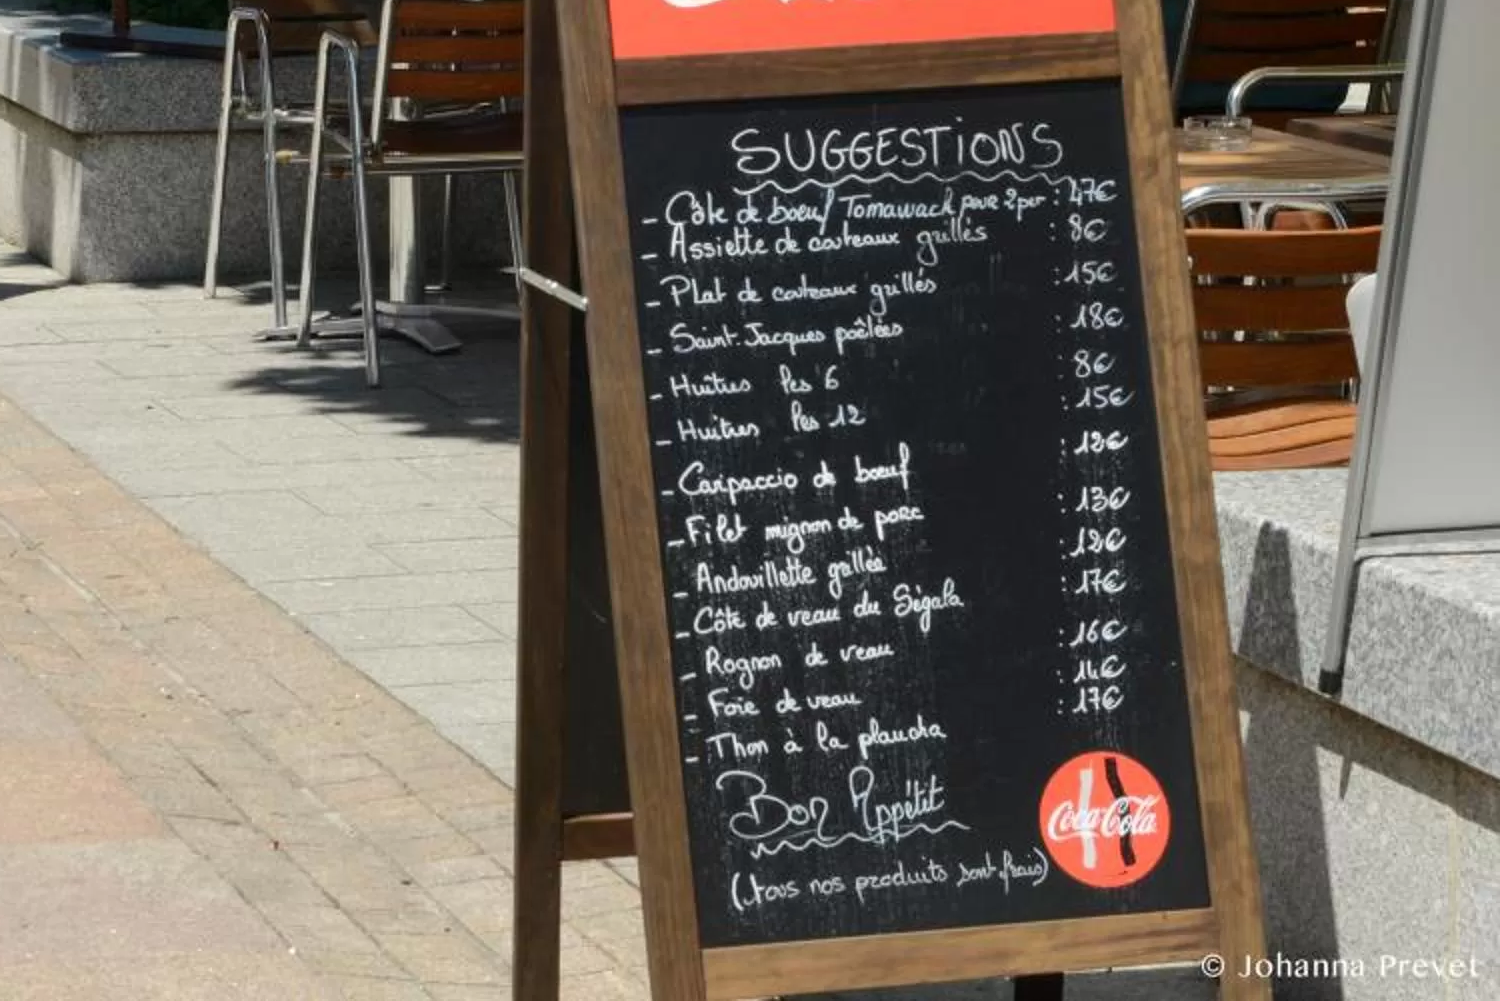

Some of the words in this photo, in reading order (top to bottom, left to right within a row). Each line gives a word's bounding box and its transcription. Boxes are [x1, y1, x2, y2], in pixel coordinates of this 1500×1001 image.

[731, 118, 1063, 175] SUGGESTIONS
[736, 194, 762, 225] de
[671, 222, 769, 263] Assiette
[775, 226, 802, 255] de
[659, 274, 728, 307] Plat
[737, 277, 763, 303] de
[779, 364, 812, 394] les
[824, 364, 839, 390] 6
[791, 400, 820, 432] les
[828, 404, 867, 427] 12
[678, 461, 799, 505] Carpaccio
[813, 460, 837, 488] de
[686, 513, 747, 545] Filet
[764, 515, 832, 553] mignon
[837, 506, 864, 530] de
[875, 506, 924, 541] porc
[696, 556, 817, 594] Andouillette
[693, 605, 746, 634] Côte
[755, 601, 778, 631] de
[788, 606, 841, 628] veau
[854, 589, 882, 618] du
[705, 645, 782, 690] Rognon
[805, 642, 828, 667] de
[840, 643, 895, 662] veau
[708, 688, 760, 717] Foie
[776, 688, 801, 714] de
[807, 692, 862, 709] veau
[706, 732, 769, 759] Thon
[817, 720, 849, 751] la
[716, 770, 837, 842] Bon
[809, 879, 847, 896] nos
[855, 856, 949, 905] produits
